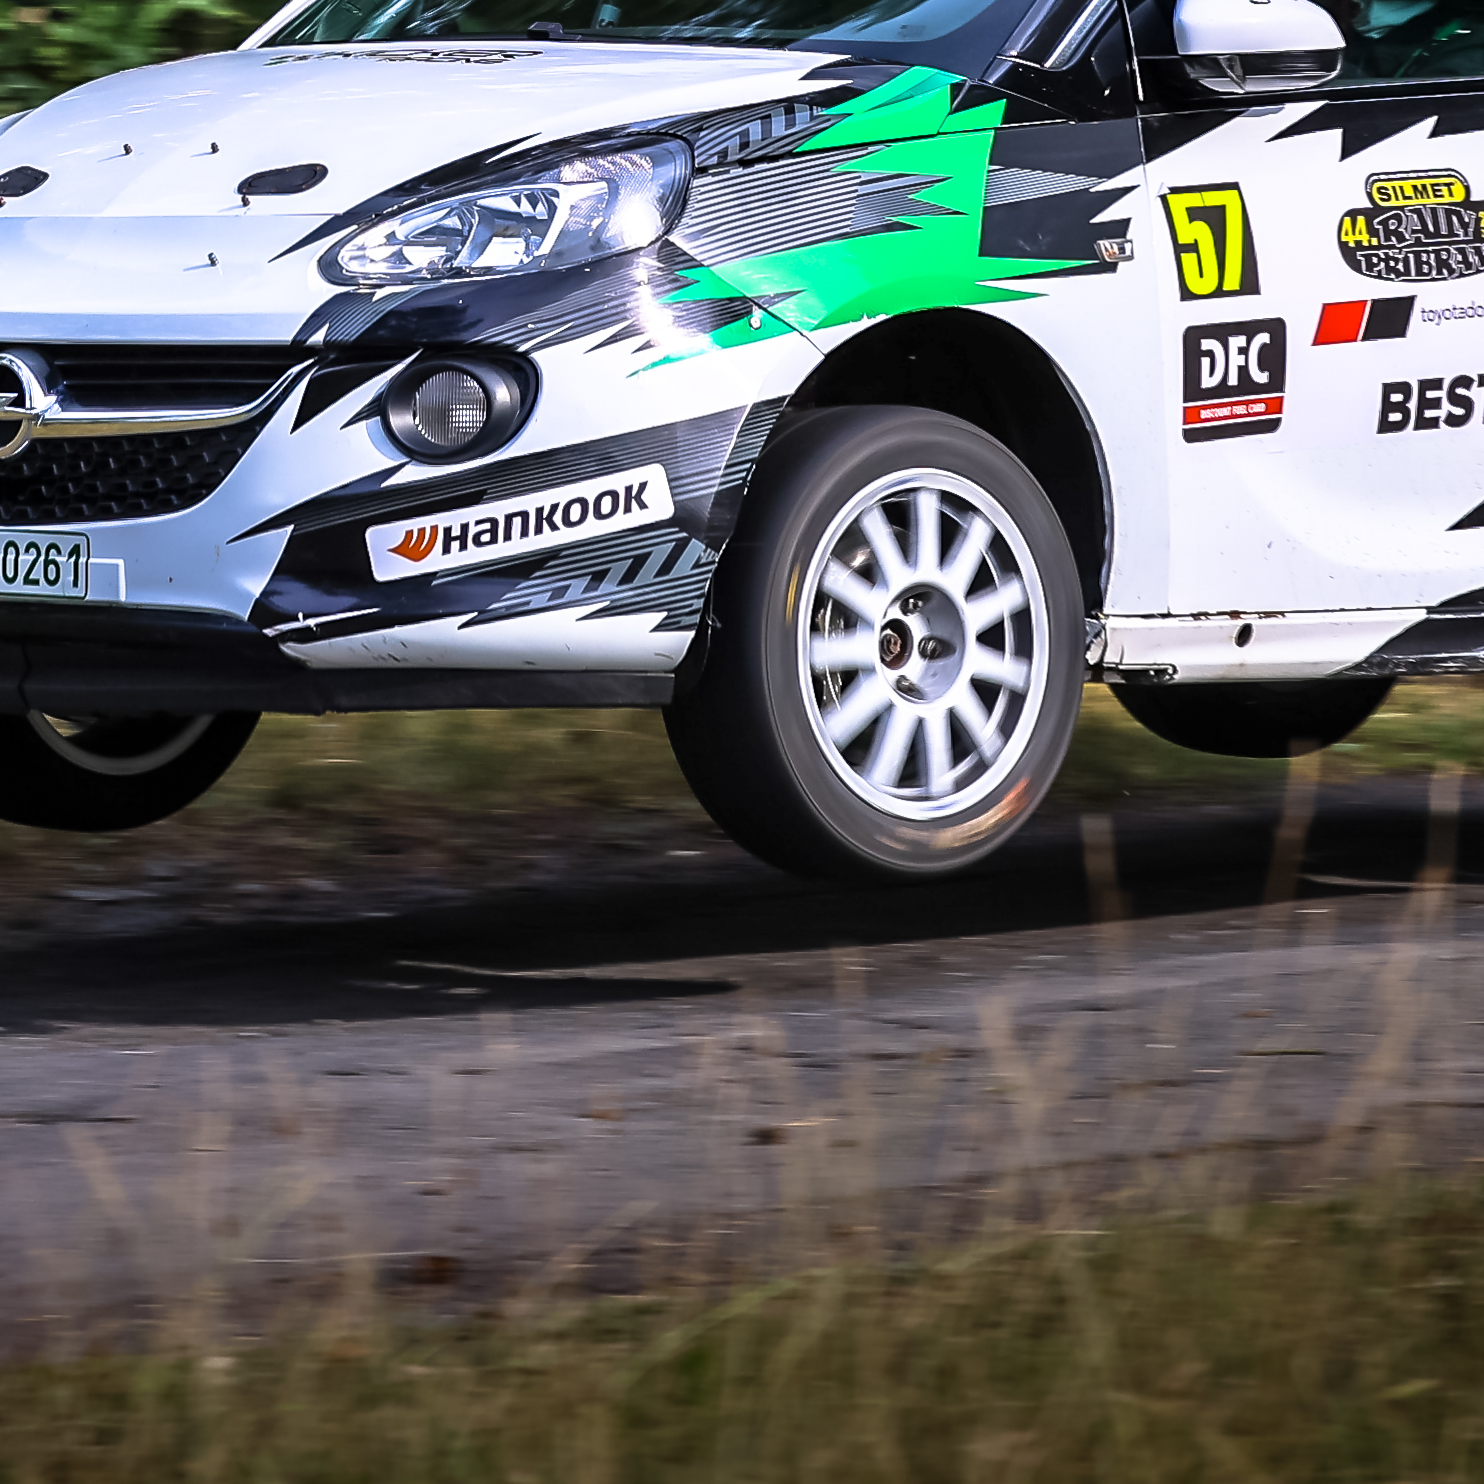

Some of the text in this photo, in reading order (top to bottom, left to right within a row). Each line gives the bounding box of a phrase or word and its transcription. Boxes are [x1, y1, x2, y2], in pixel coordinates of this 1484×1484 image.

[1376, 182, 1456, 203] SILMET
[1166, 189, 1246, 295] 57
[1373, 204, 1478, 248] RALLY
[1200, 331, 1271, 389] DFC
[1, 539, 82, 589] 0261
